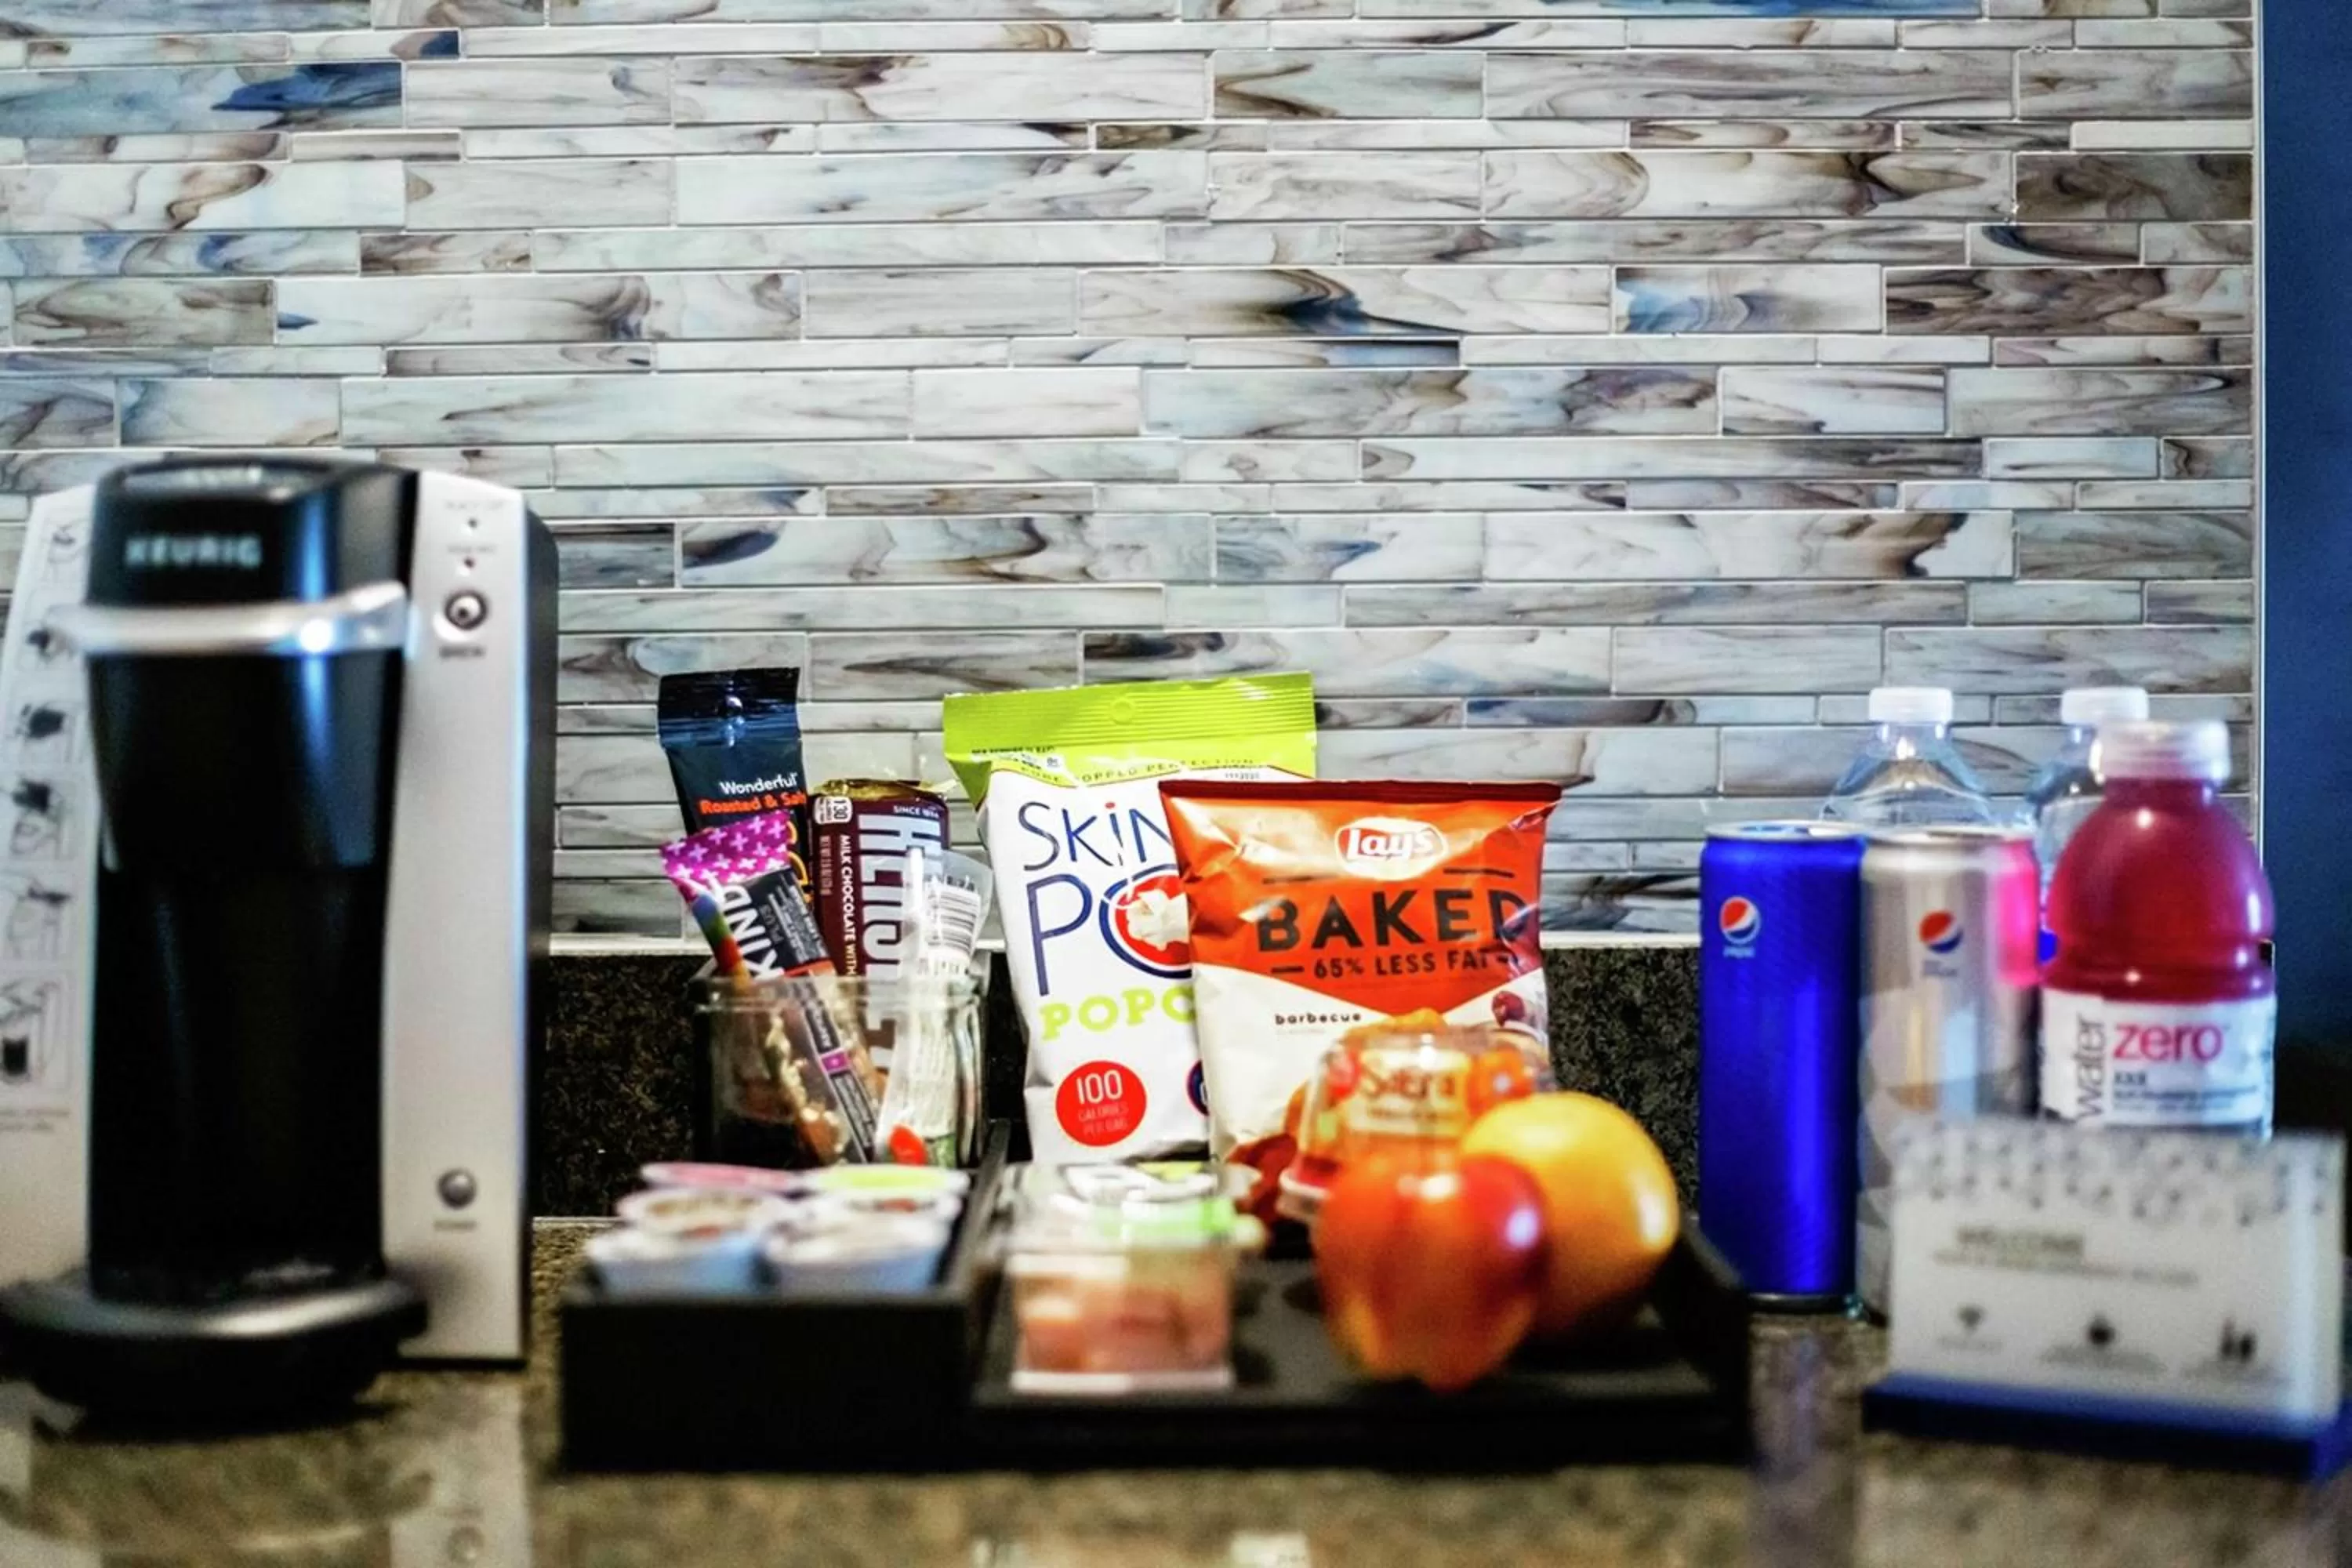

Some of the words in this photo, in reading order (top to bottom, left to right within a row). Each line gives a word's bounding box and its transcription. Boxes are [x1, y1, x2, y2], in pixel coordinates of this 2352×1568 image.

[719, 771, 797, 794] Wonderful
[840, 834, 853, 864] MILK
[841, 866, 857, 941] CHOCOLATE
[1259, 890, 1531, 951] BAKED
[722, 884, 786, 980] KIND
[845, 942, 858, 976] WITH
[1313, 958, 1364, 979] 65%
[1375, 953, 1436, 975] LESS
[1276, 1013, 1361, 1025] barbecue
[2113, 1022, 2224, 1060] zero
[2074, 1014, 2105, 1119] water
[1077, 1070, 1123, 1104] 100
